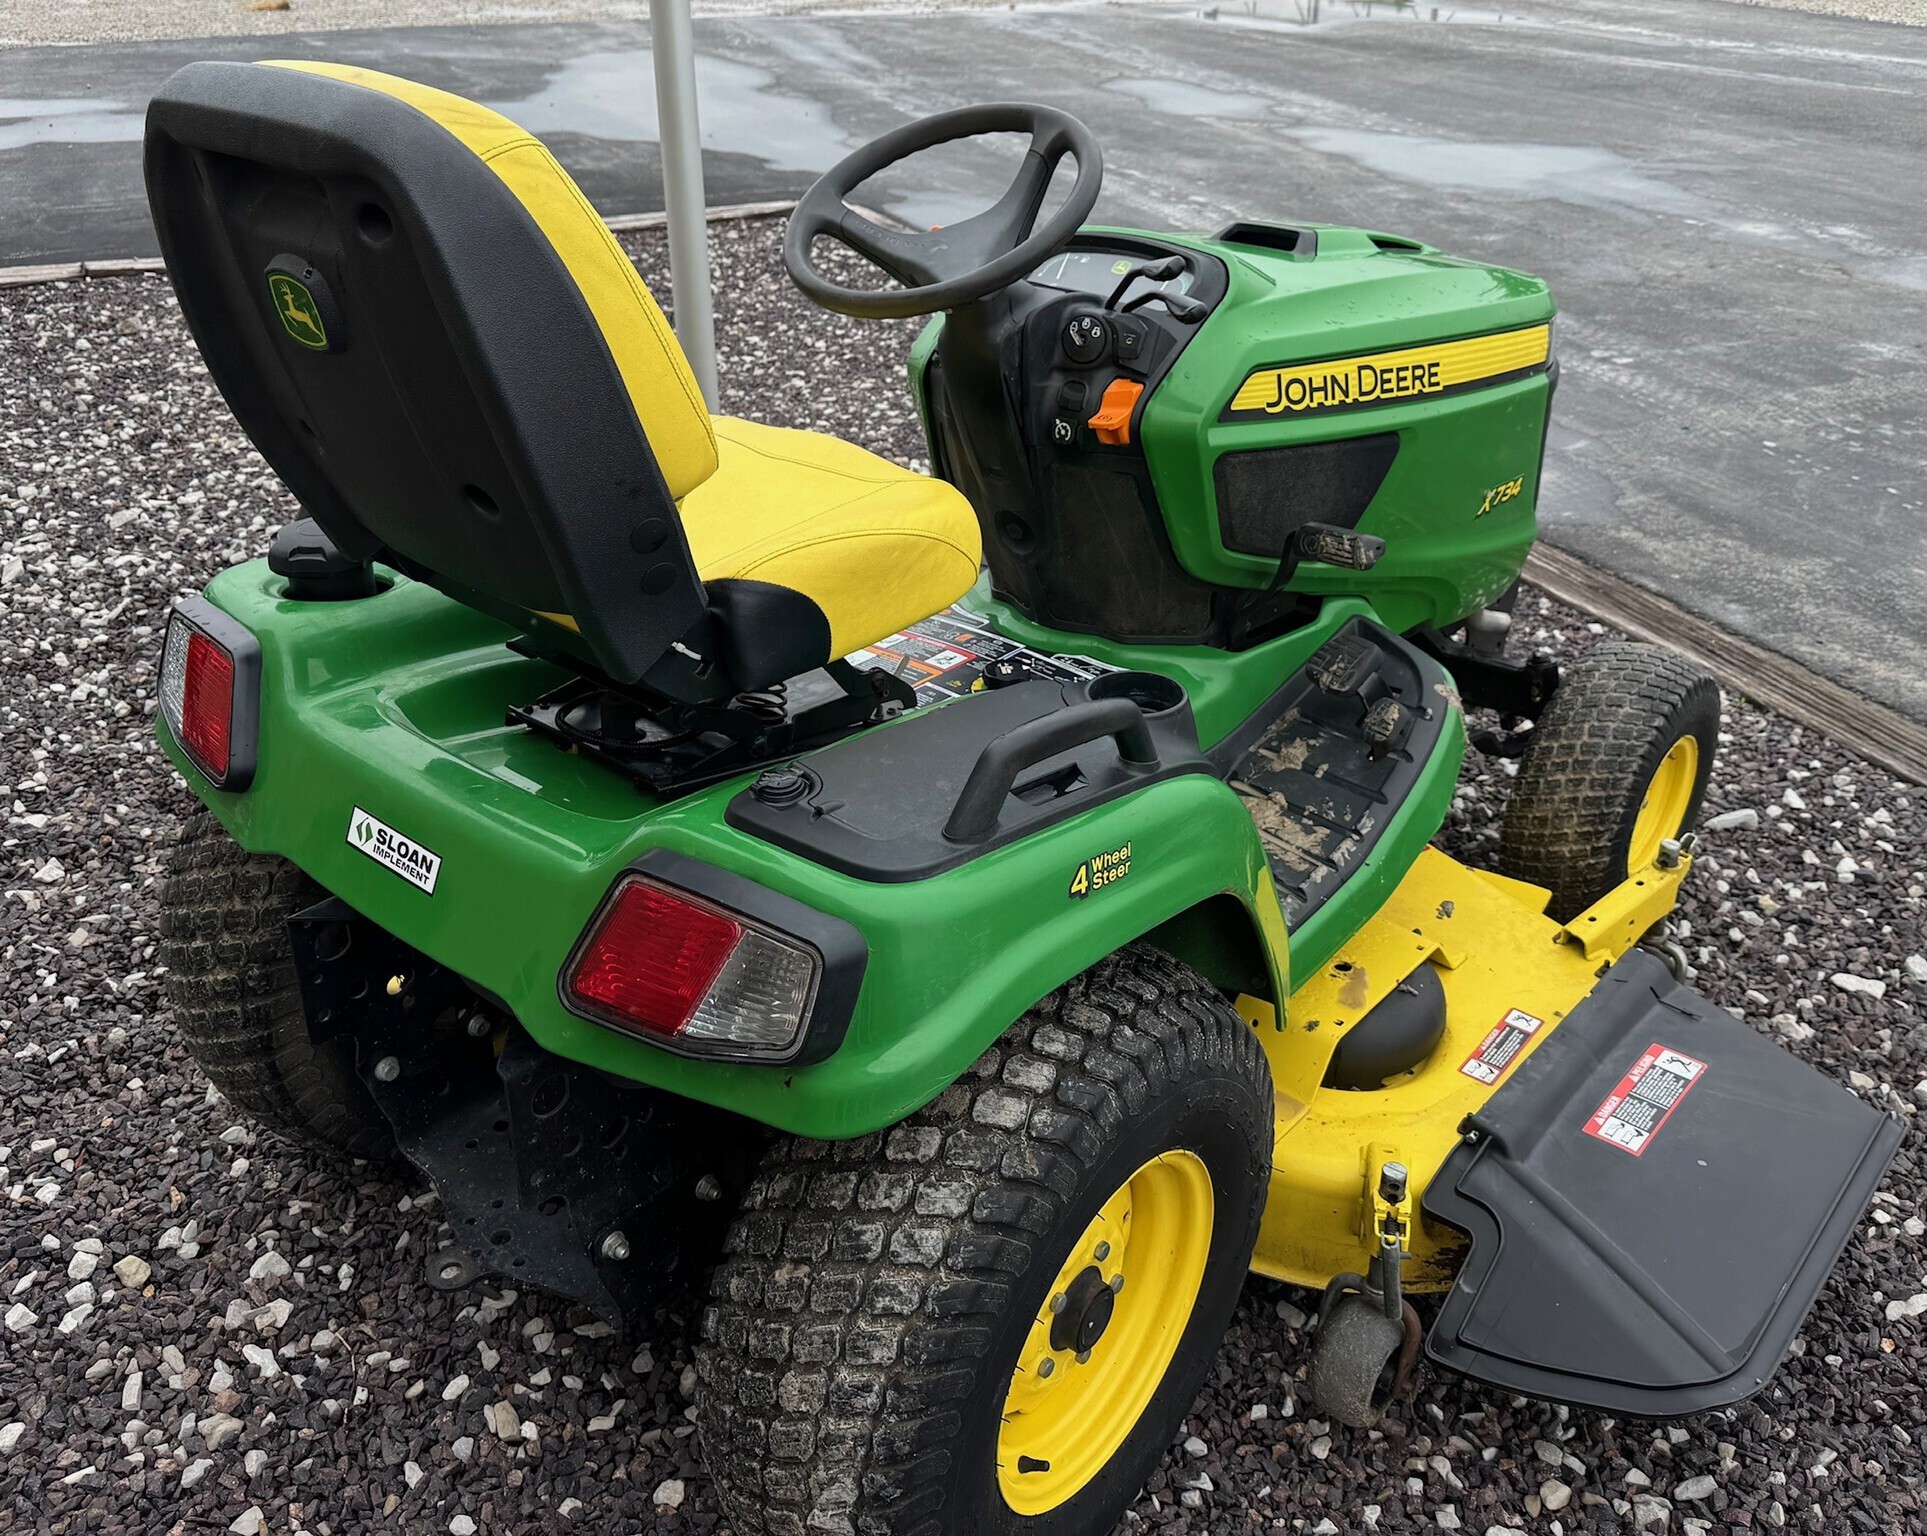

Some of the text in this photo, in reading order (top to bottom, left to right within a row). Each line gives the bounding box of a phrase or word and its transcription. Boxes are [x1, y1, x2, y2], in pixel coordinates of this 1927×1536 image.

[1265, 362, 1440, 407] JOHN DEERE
[1476, 475, 1524, 517] X734
[373, 844, 429, 884] IMPLEMENT
[376, 828, 433, 874] SLOAN
[1070, 841, 1131, 899] 4 Wheel
[1092, 861, 1131, 889] Steer
